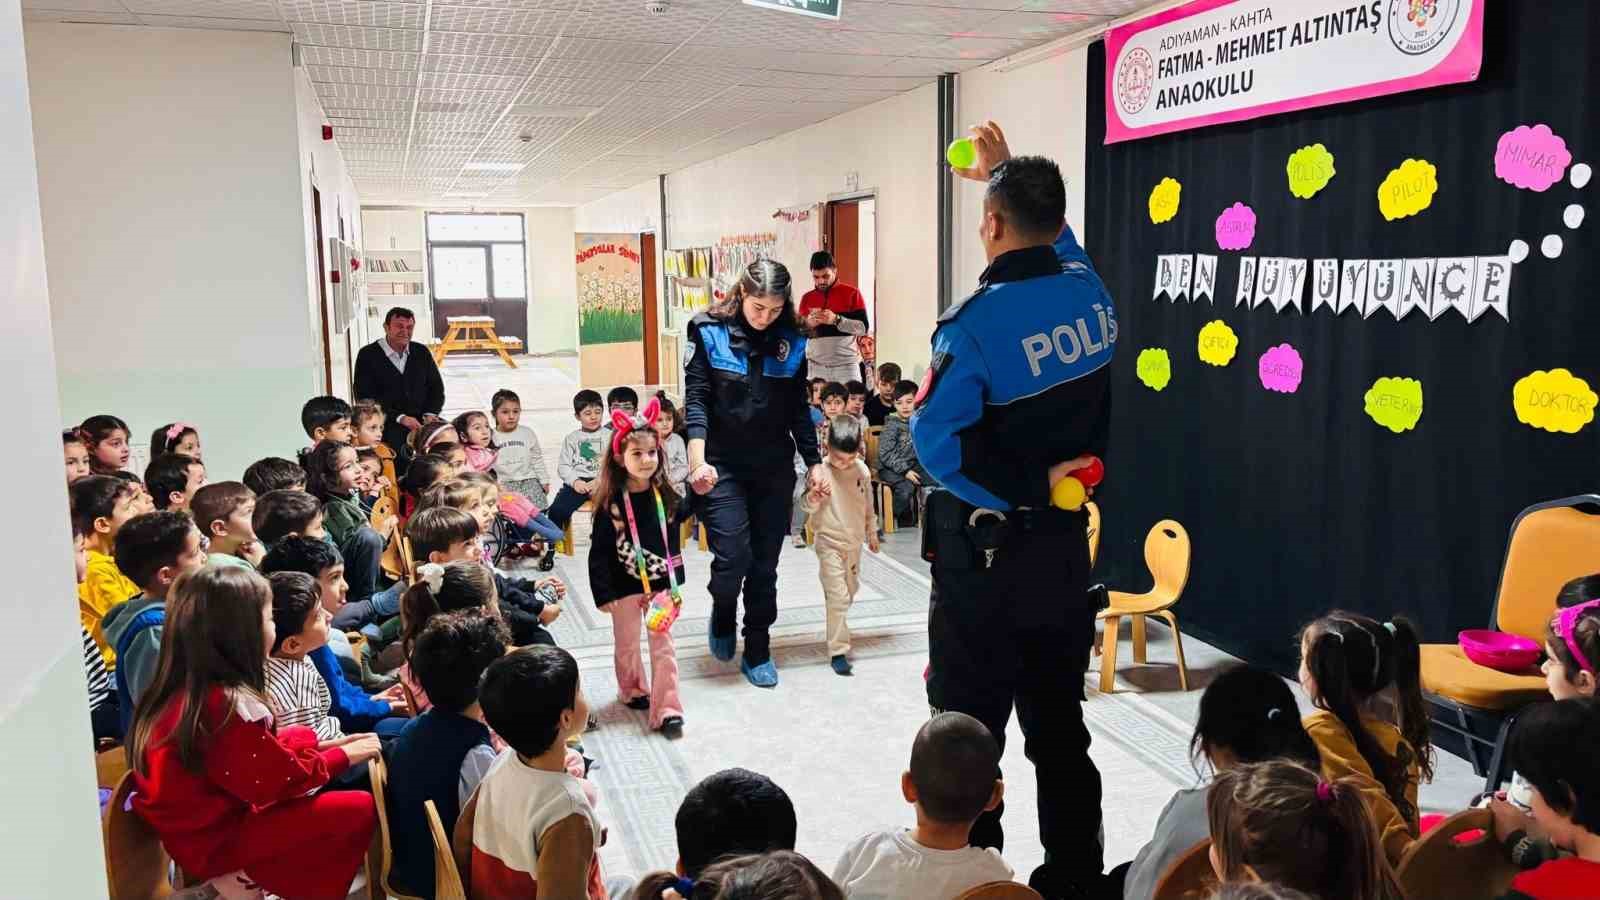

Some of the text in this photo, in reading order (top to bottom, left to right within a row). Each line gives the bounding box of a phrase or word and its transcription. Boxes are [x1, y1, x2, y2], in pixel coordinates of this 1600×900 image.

[1158, 48, 1204, 79] FATMA
[1215, 26, 1287, 66] MEHMET
[1290, 1, 1382, 48] ALTINTAŞ
[1160, 22, 1220, 51] ADIYAMAN
[1230, 7, 1273, 32] KAHTA
[1156, 69, 1254, 110] ANAOKULU
[1021, 303, 1119, 377] POLİS
